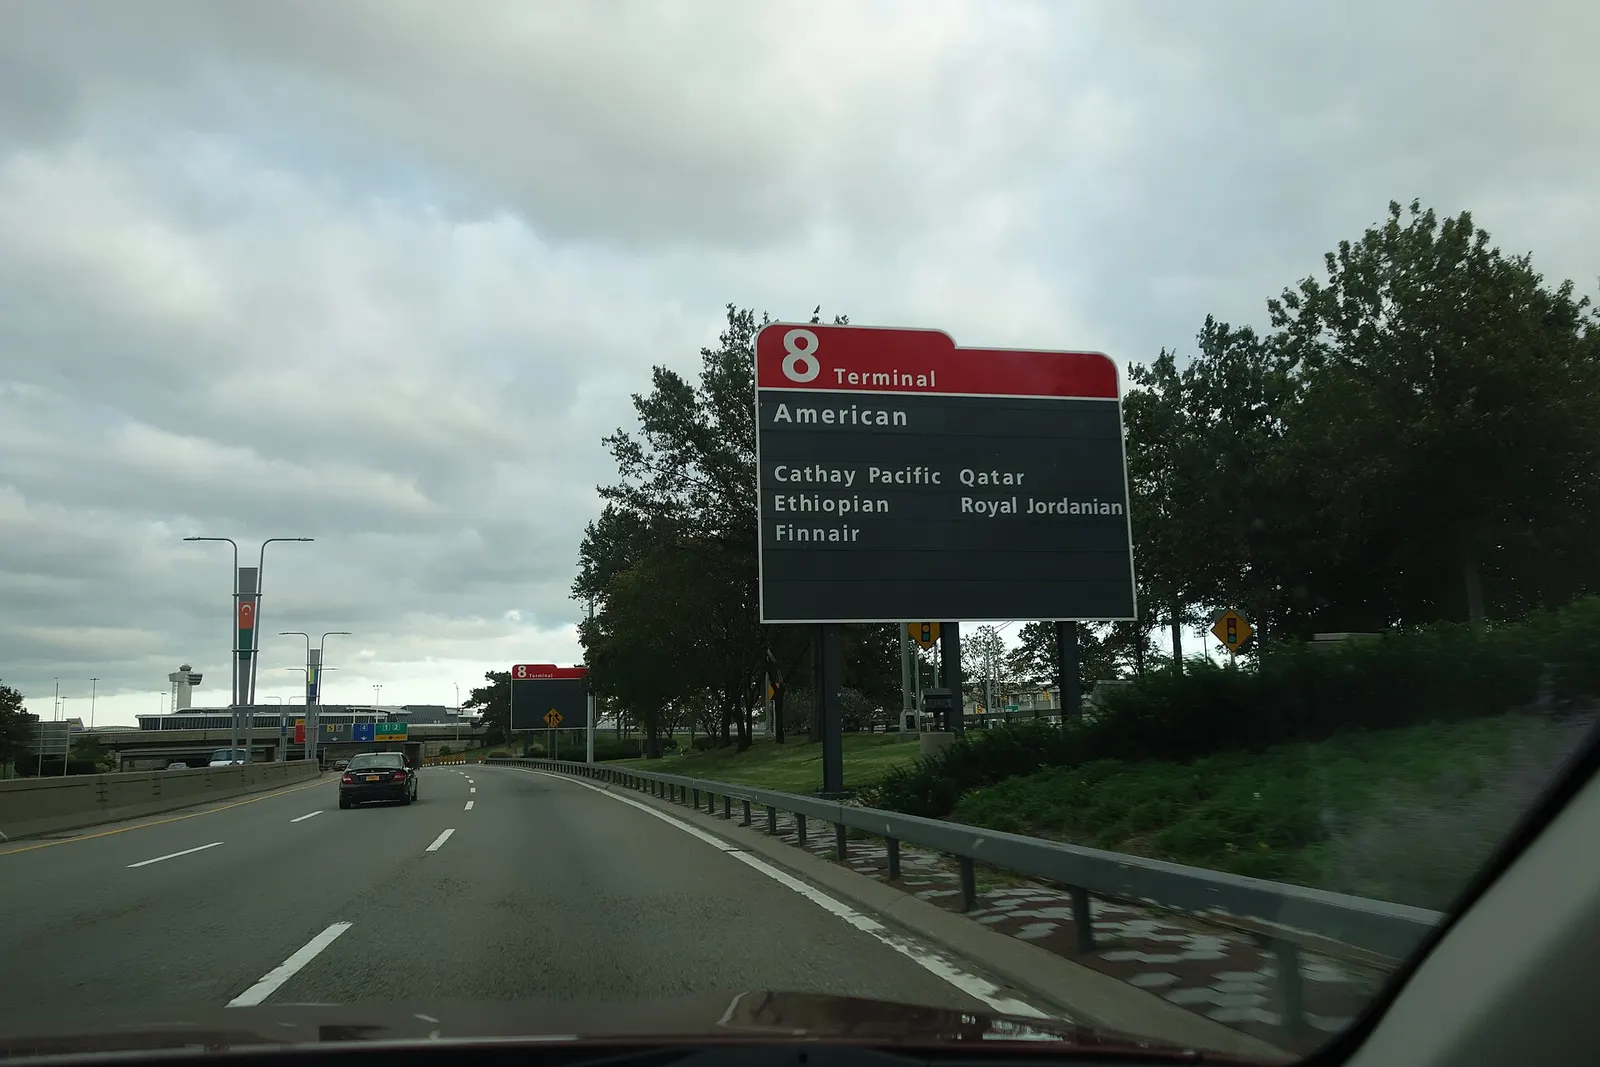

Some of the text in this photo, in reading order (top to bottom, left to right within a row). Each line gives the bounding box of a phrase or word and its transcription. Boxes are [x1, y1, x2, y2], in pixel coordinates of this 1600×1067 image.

[782, 328, 936, 388] 8 Terminal
[774, 403, 908, 426] American
[774, 465, 941, 487] Cathay Pacific
[959, 468, 1024, 487] Qatar
[774, 494, 889, 516] Ethiopian
[961, 497, 1122, 518] Royal Jordanian
[776, 524, 860, 542] Finnair
[517, 665, 527, 678] 8
